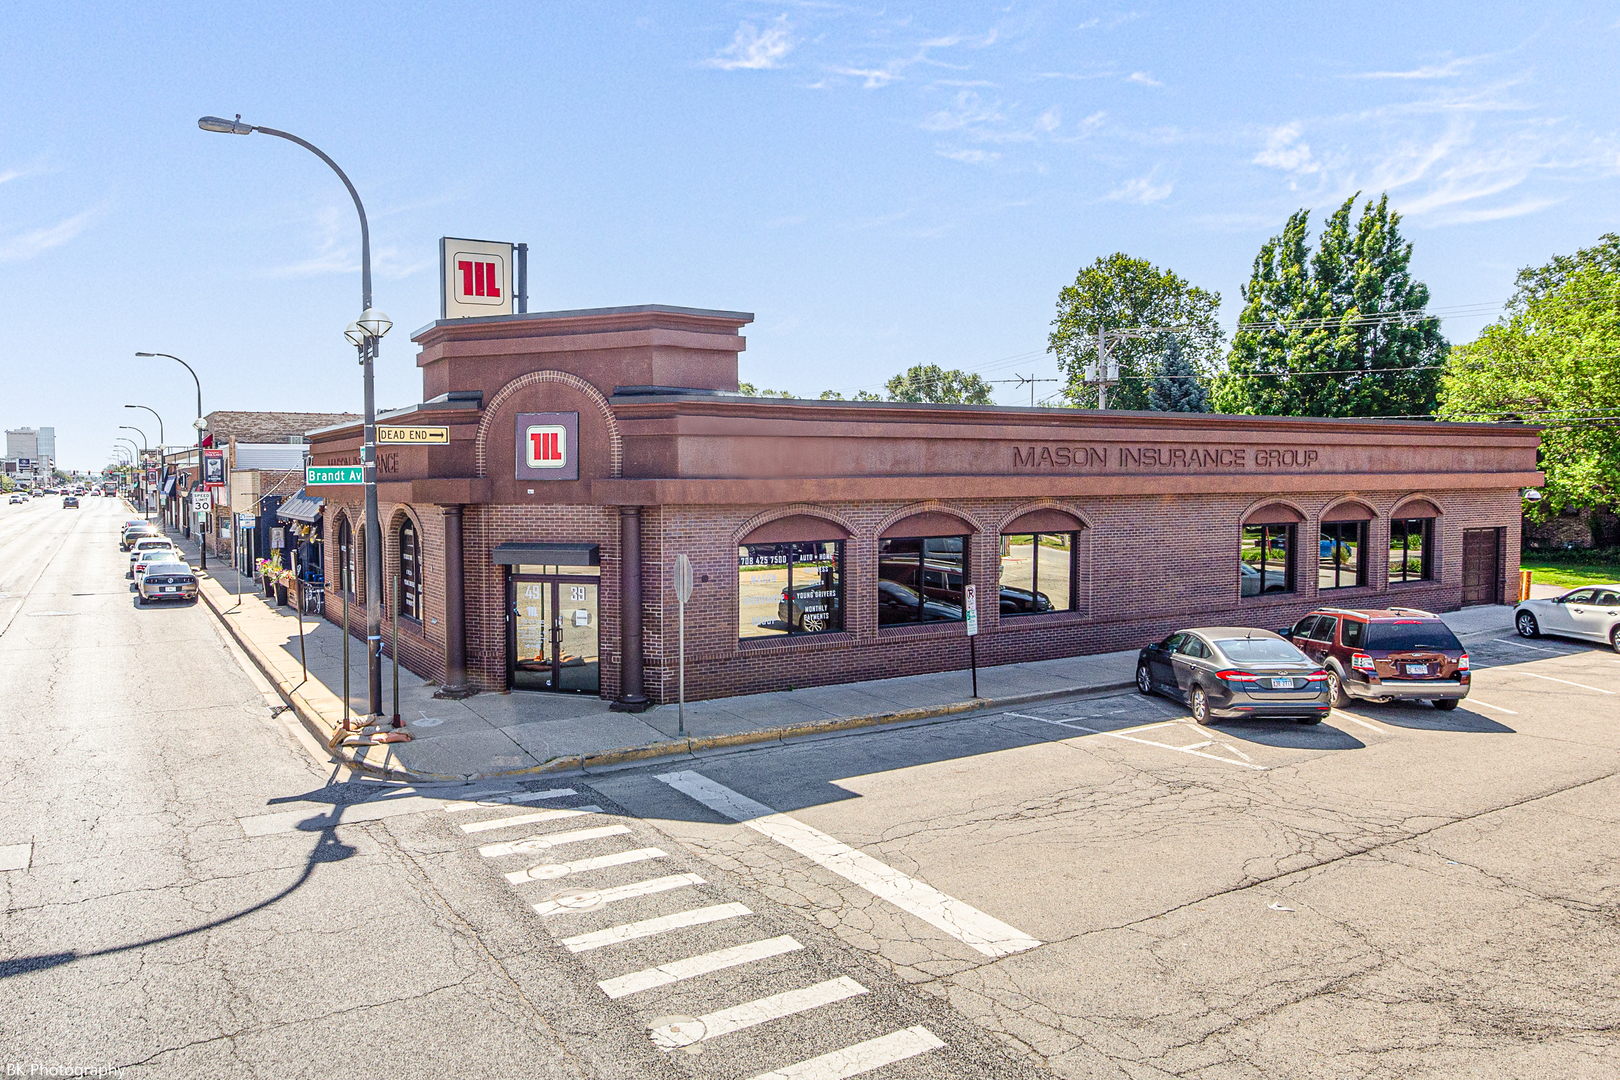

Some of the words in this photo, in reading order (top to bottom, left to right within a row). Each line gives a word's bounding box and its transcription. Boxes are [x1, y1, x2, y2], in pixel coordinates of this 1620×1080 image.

[381, 430, 405, 440] DEAD
[410, 430, 427, 440] END
[1013, 446, 1107, 467] MASON
[1118, 448, 1245, 468] INSURANCE
[1255, 449, 1318, 467] GROUP
[309, 470, 345, 481] Brandt
[349, 470, 362, 481] Av
[195, 502, 210, 510] 30
[741, 557, 754, 565] 708
[756, 556, 769, 564] 425
[771, 555, 787, 564] 7500
[800, 553, 813, 561] AUTO
[751, 574, 777, 584] MASON
[525, 585, 540, 600] 49
[570, 586, 585, 601] 39
[797, 591, 814, 599] YOUNG
[814, 590, 836, 598] DRIVERS
[742, 593, 785, 606] INSURANCE
[805, 604, 828, 613] MONTHLY
[751, 616, 777, 626] GROUP
[803, 612, 830, 620] PAYMENTS
